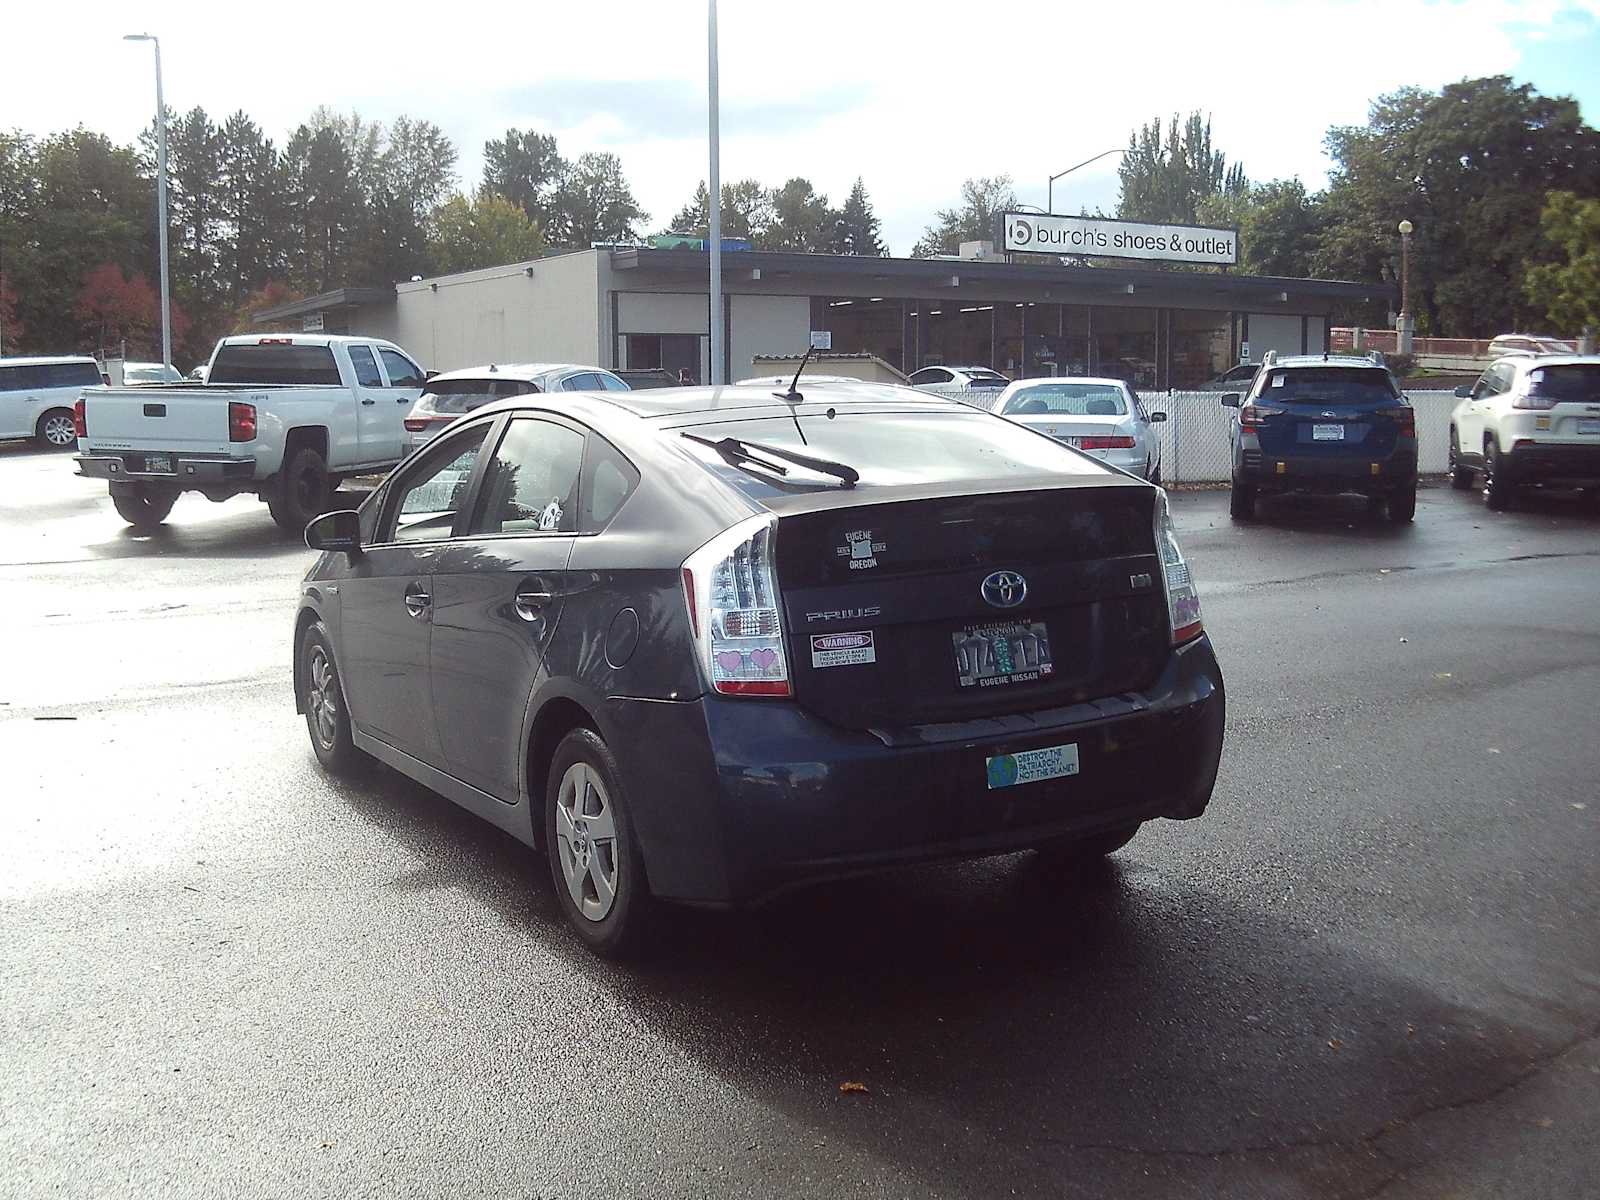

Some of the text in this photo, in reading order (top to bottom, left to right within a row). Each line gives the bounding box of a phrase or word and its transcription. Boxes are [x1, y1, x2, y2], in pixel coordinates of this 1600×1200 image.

[1036, 223, 1108, 247] burch's
[1113, 229, 1167, 252] shoes
[1169, 234, 1182, 252] &
[1185, 237, 1233, 256] outlet
[845, 530, 872, 543] EUGENE
[849, 558, 878, 570] OREGON
[806, 606, 881, 622] PRIUS
[823, 637, 863, 647] WARNING
[980, 671, 1039, 687] EUGENE NISSAN
[1018, 751, 1048, 762] DESTROY
[1019, 763, 1075, 780] NOT THE PLANET
